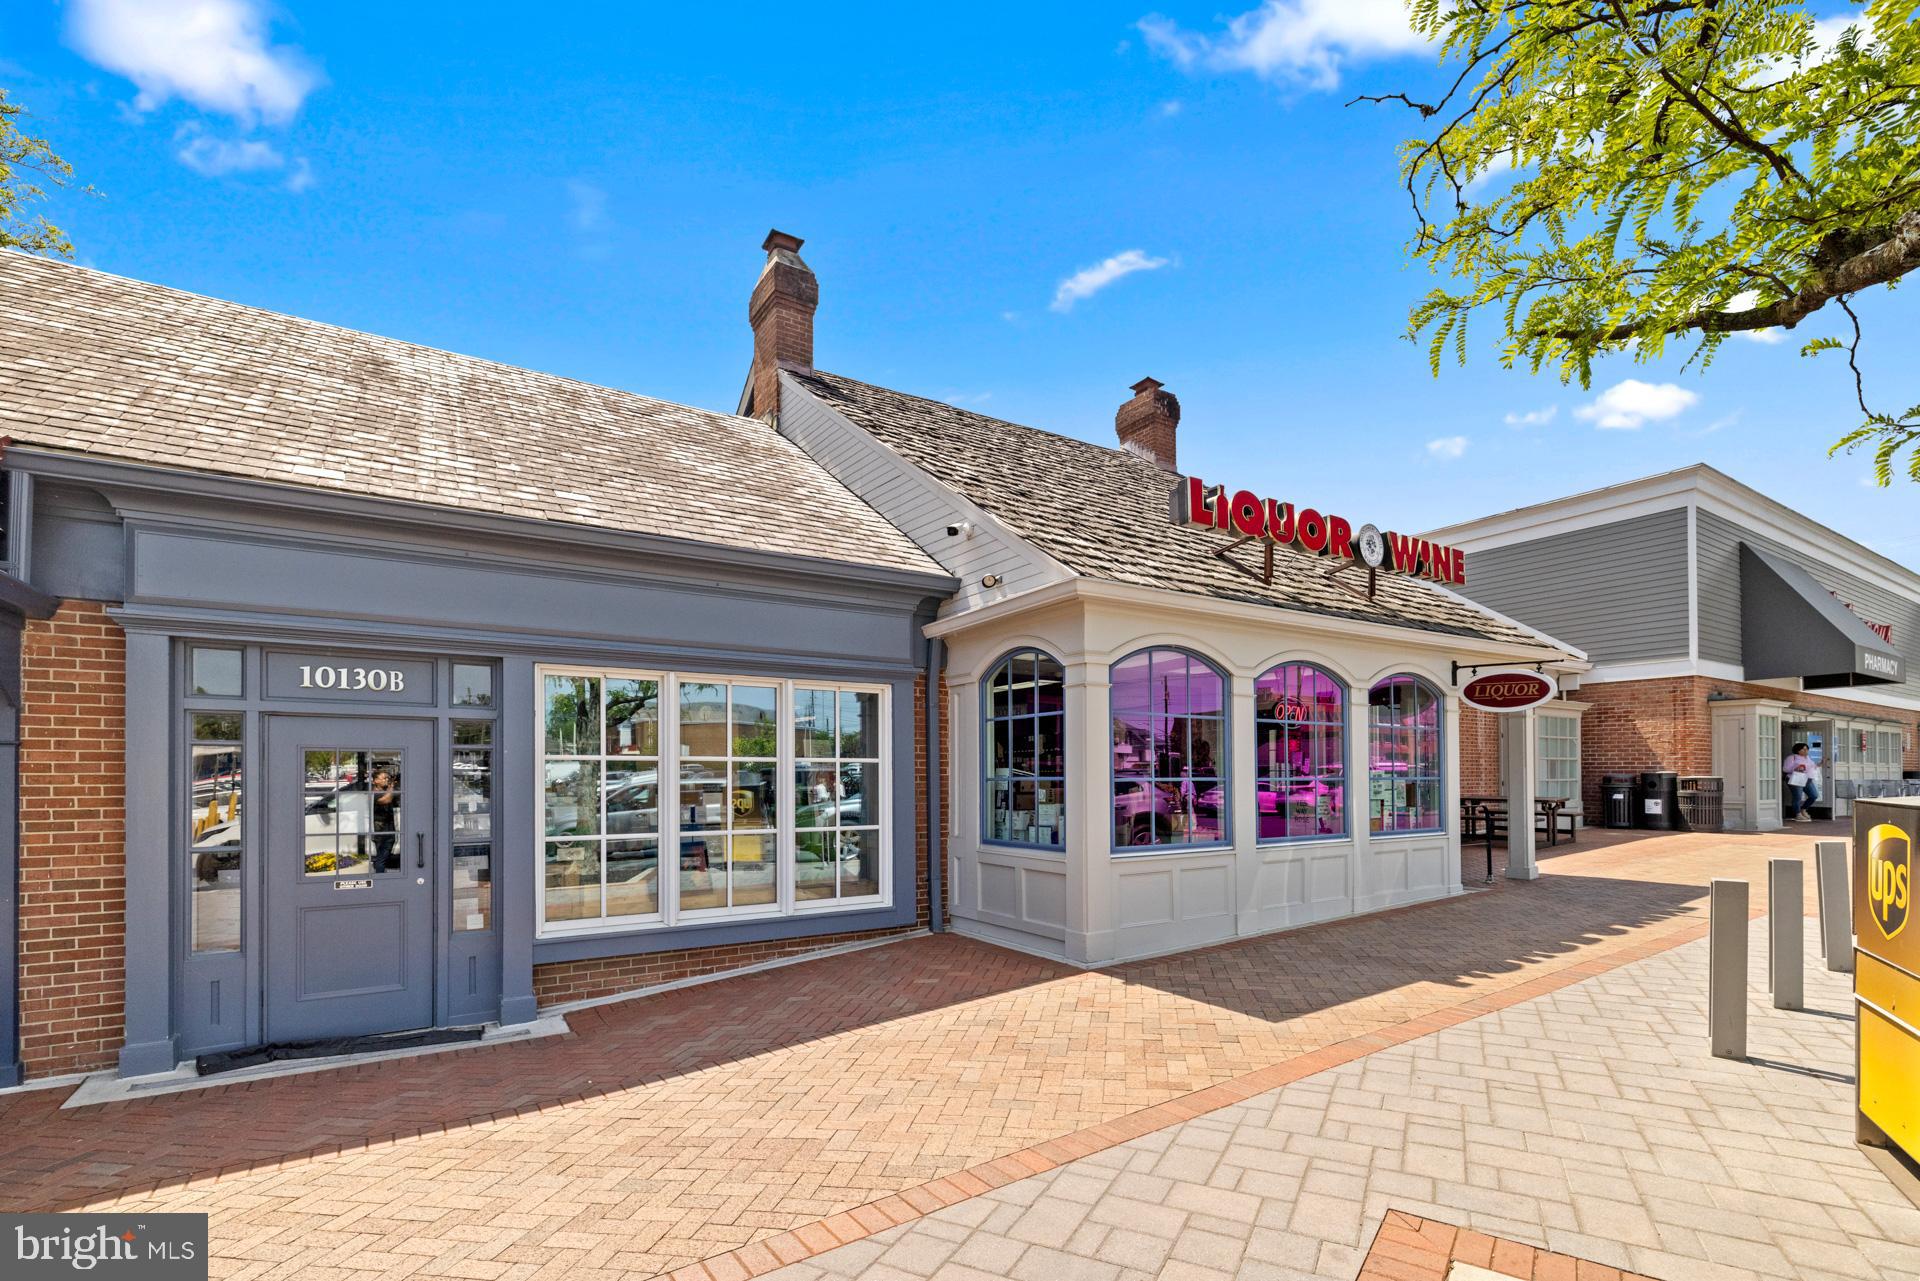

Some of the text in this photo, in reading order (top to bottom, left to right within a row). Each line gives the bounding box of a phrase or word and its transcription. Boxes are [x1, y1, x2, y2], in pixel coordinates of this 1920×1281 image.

[1188, 476, 1354, 559] LIQUOR
[1388, 531, 1466, 585] WINE
[1864, 653, 1898, 676] PHARMACY
[299, 665, 404, 692] 10130B
[1473, 680, 1541, 702] LIQUOR
[1275, 704, 1304, 721] OPEN
[1870, 858, 1908, 922] ups
